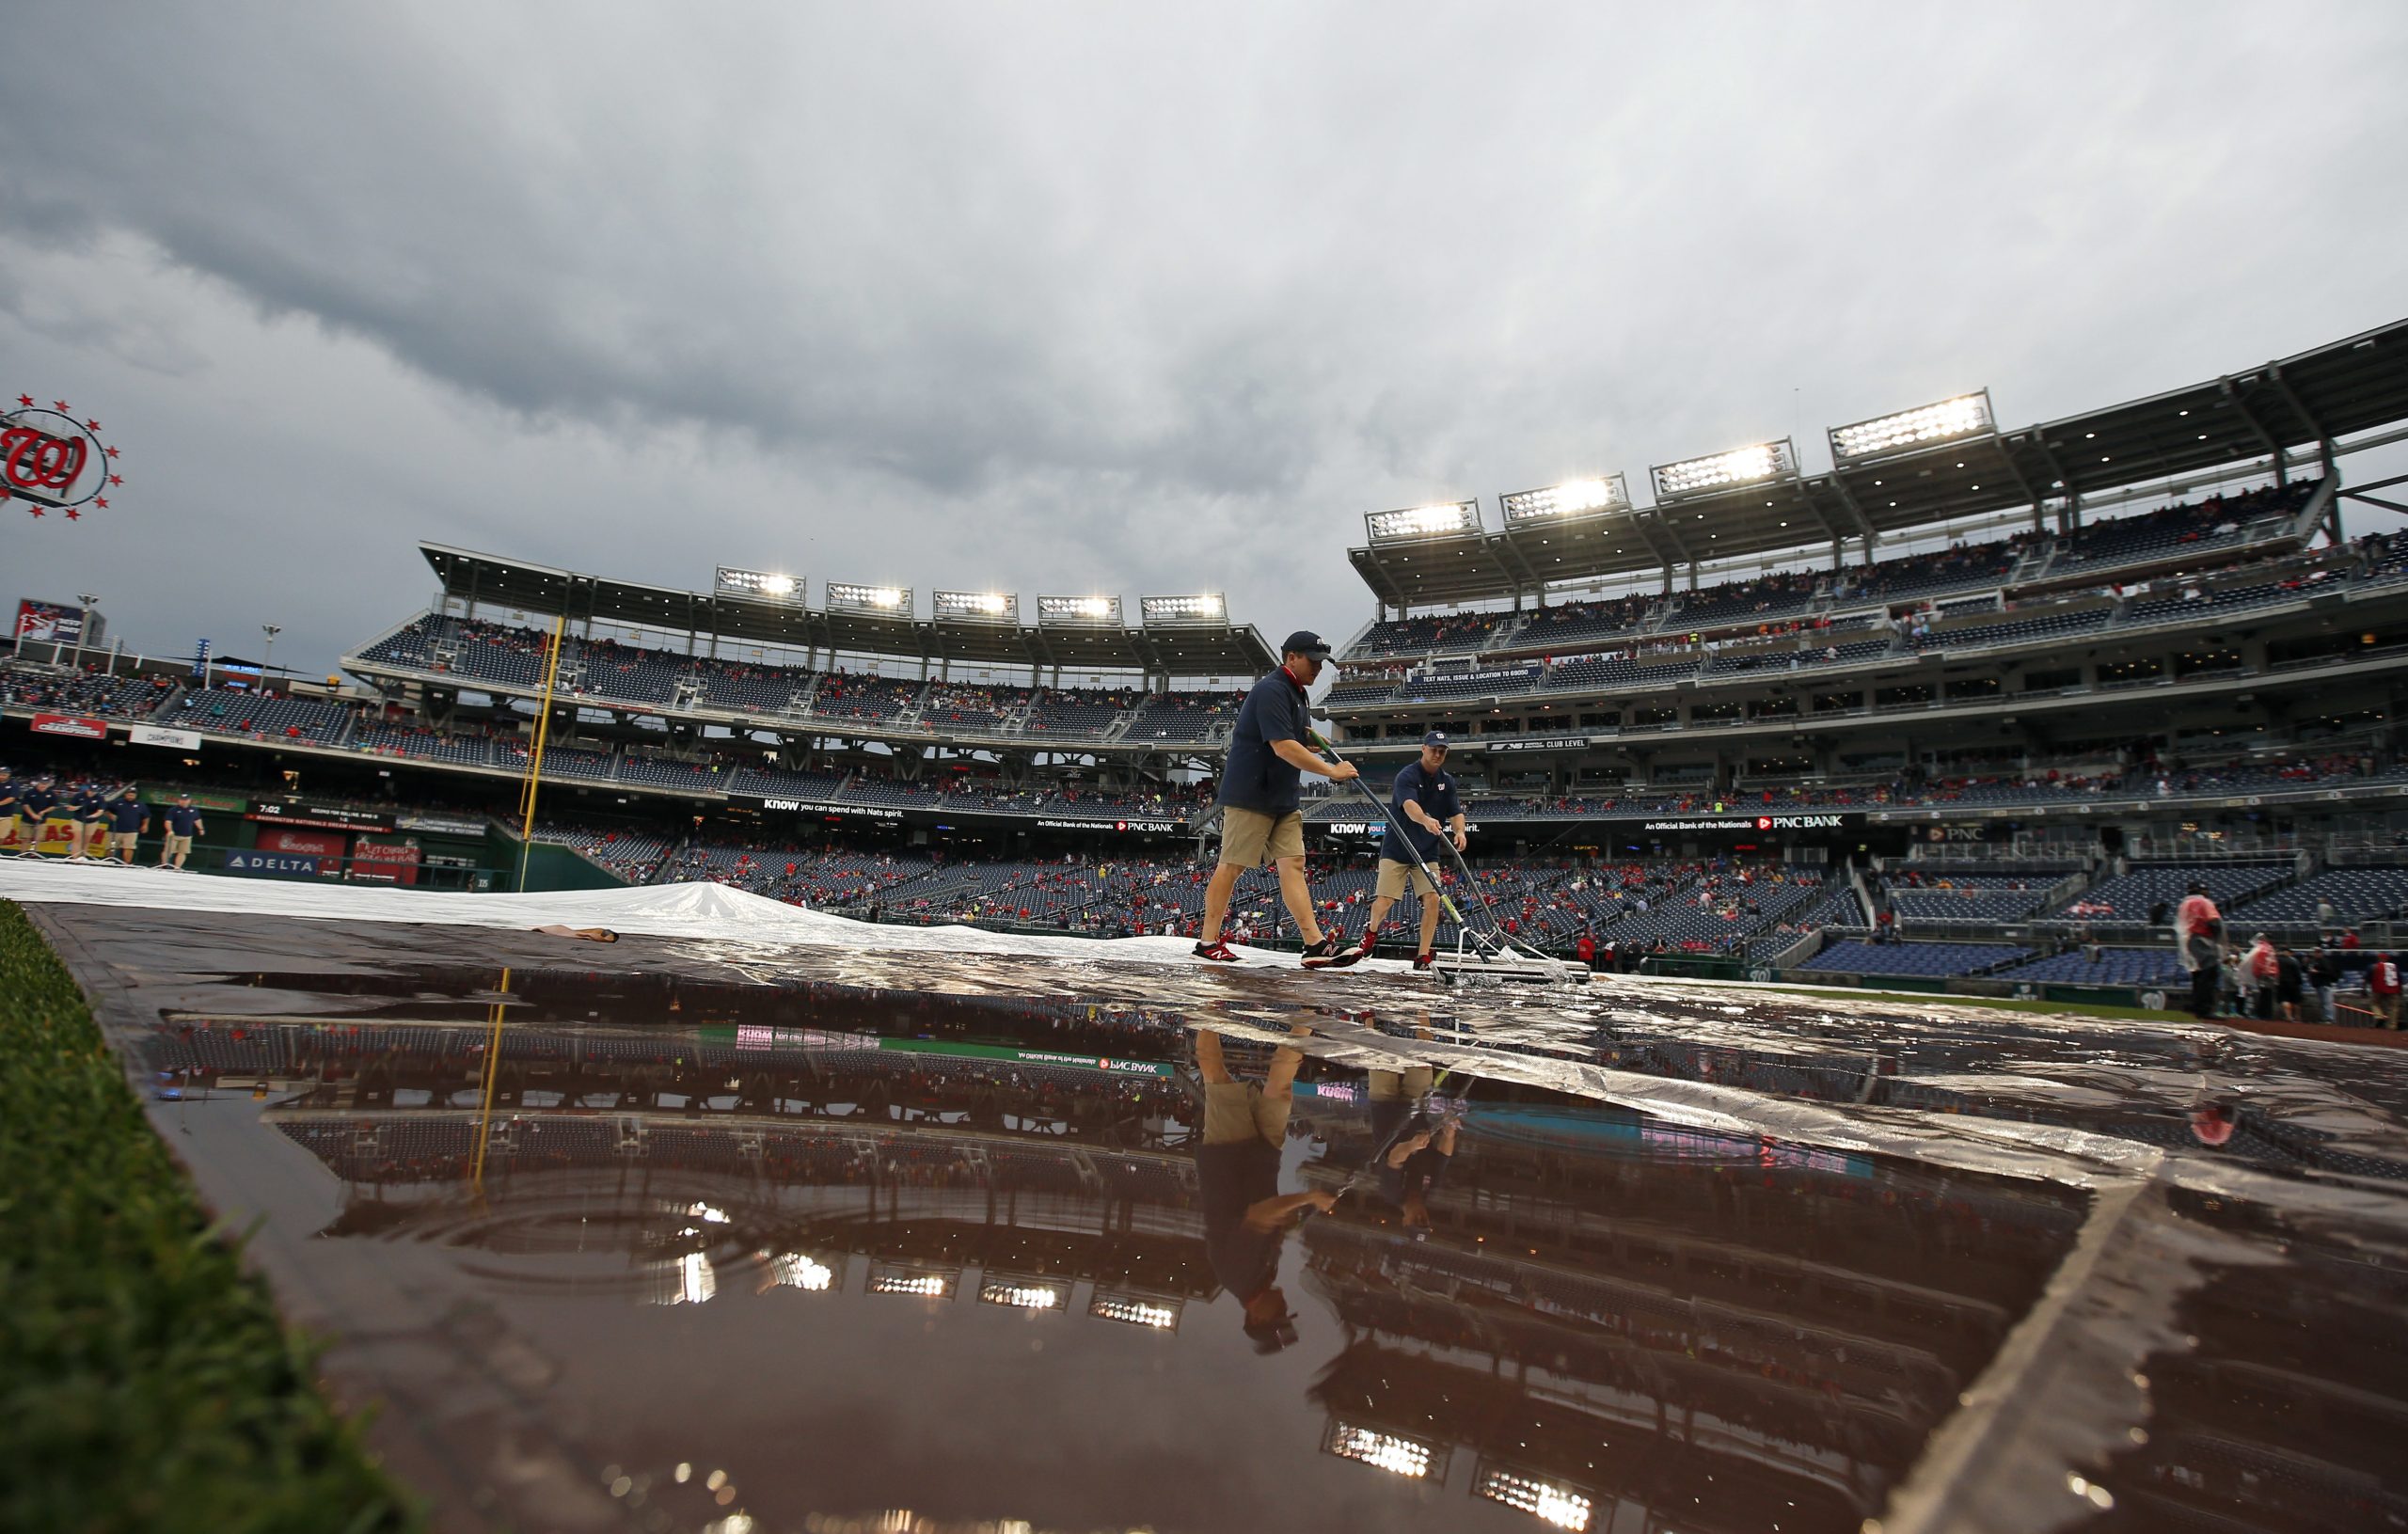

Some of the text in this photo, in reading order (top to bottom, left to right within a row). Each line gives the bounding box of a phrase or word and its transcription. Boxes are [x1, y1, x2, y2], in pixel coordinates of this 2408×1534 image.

[1476, 671, 1501, 679] LOCATION
[260, 804, 280, 814] 7:02
[829, 806, 850, 814] spend
[884, 810, 903, 818] spirit.
[1128, 823, 1147, 831] PNC
[1148, 823, 1173, 832] BANK
[1718, 820, 1752, 829] Nationals
[1773, 818, 1802, 828] PNC
[1803, 815, 1843, 828] BANK
[1368, 824, 1381, 835] you
[1948, 828, 1984, 840] PNC
[251, 857, 313, 871] DELTA
[478, 879, 488, 888] 335
